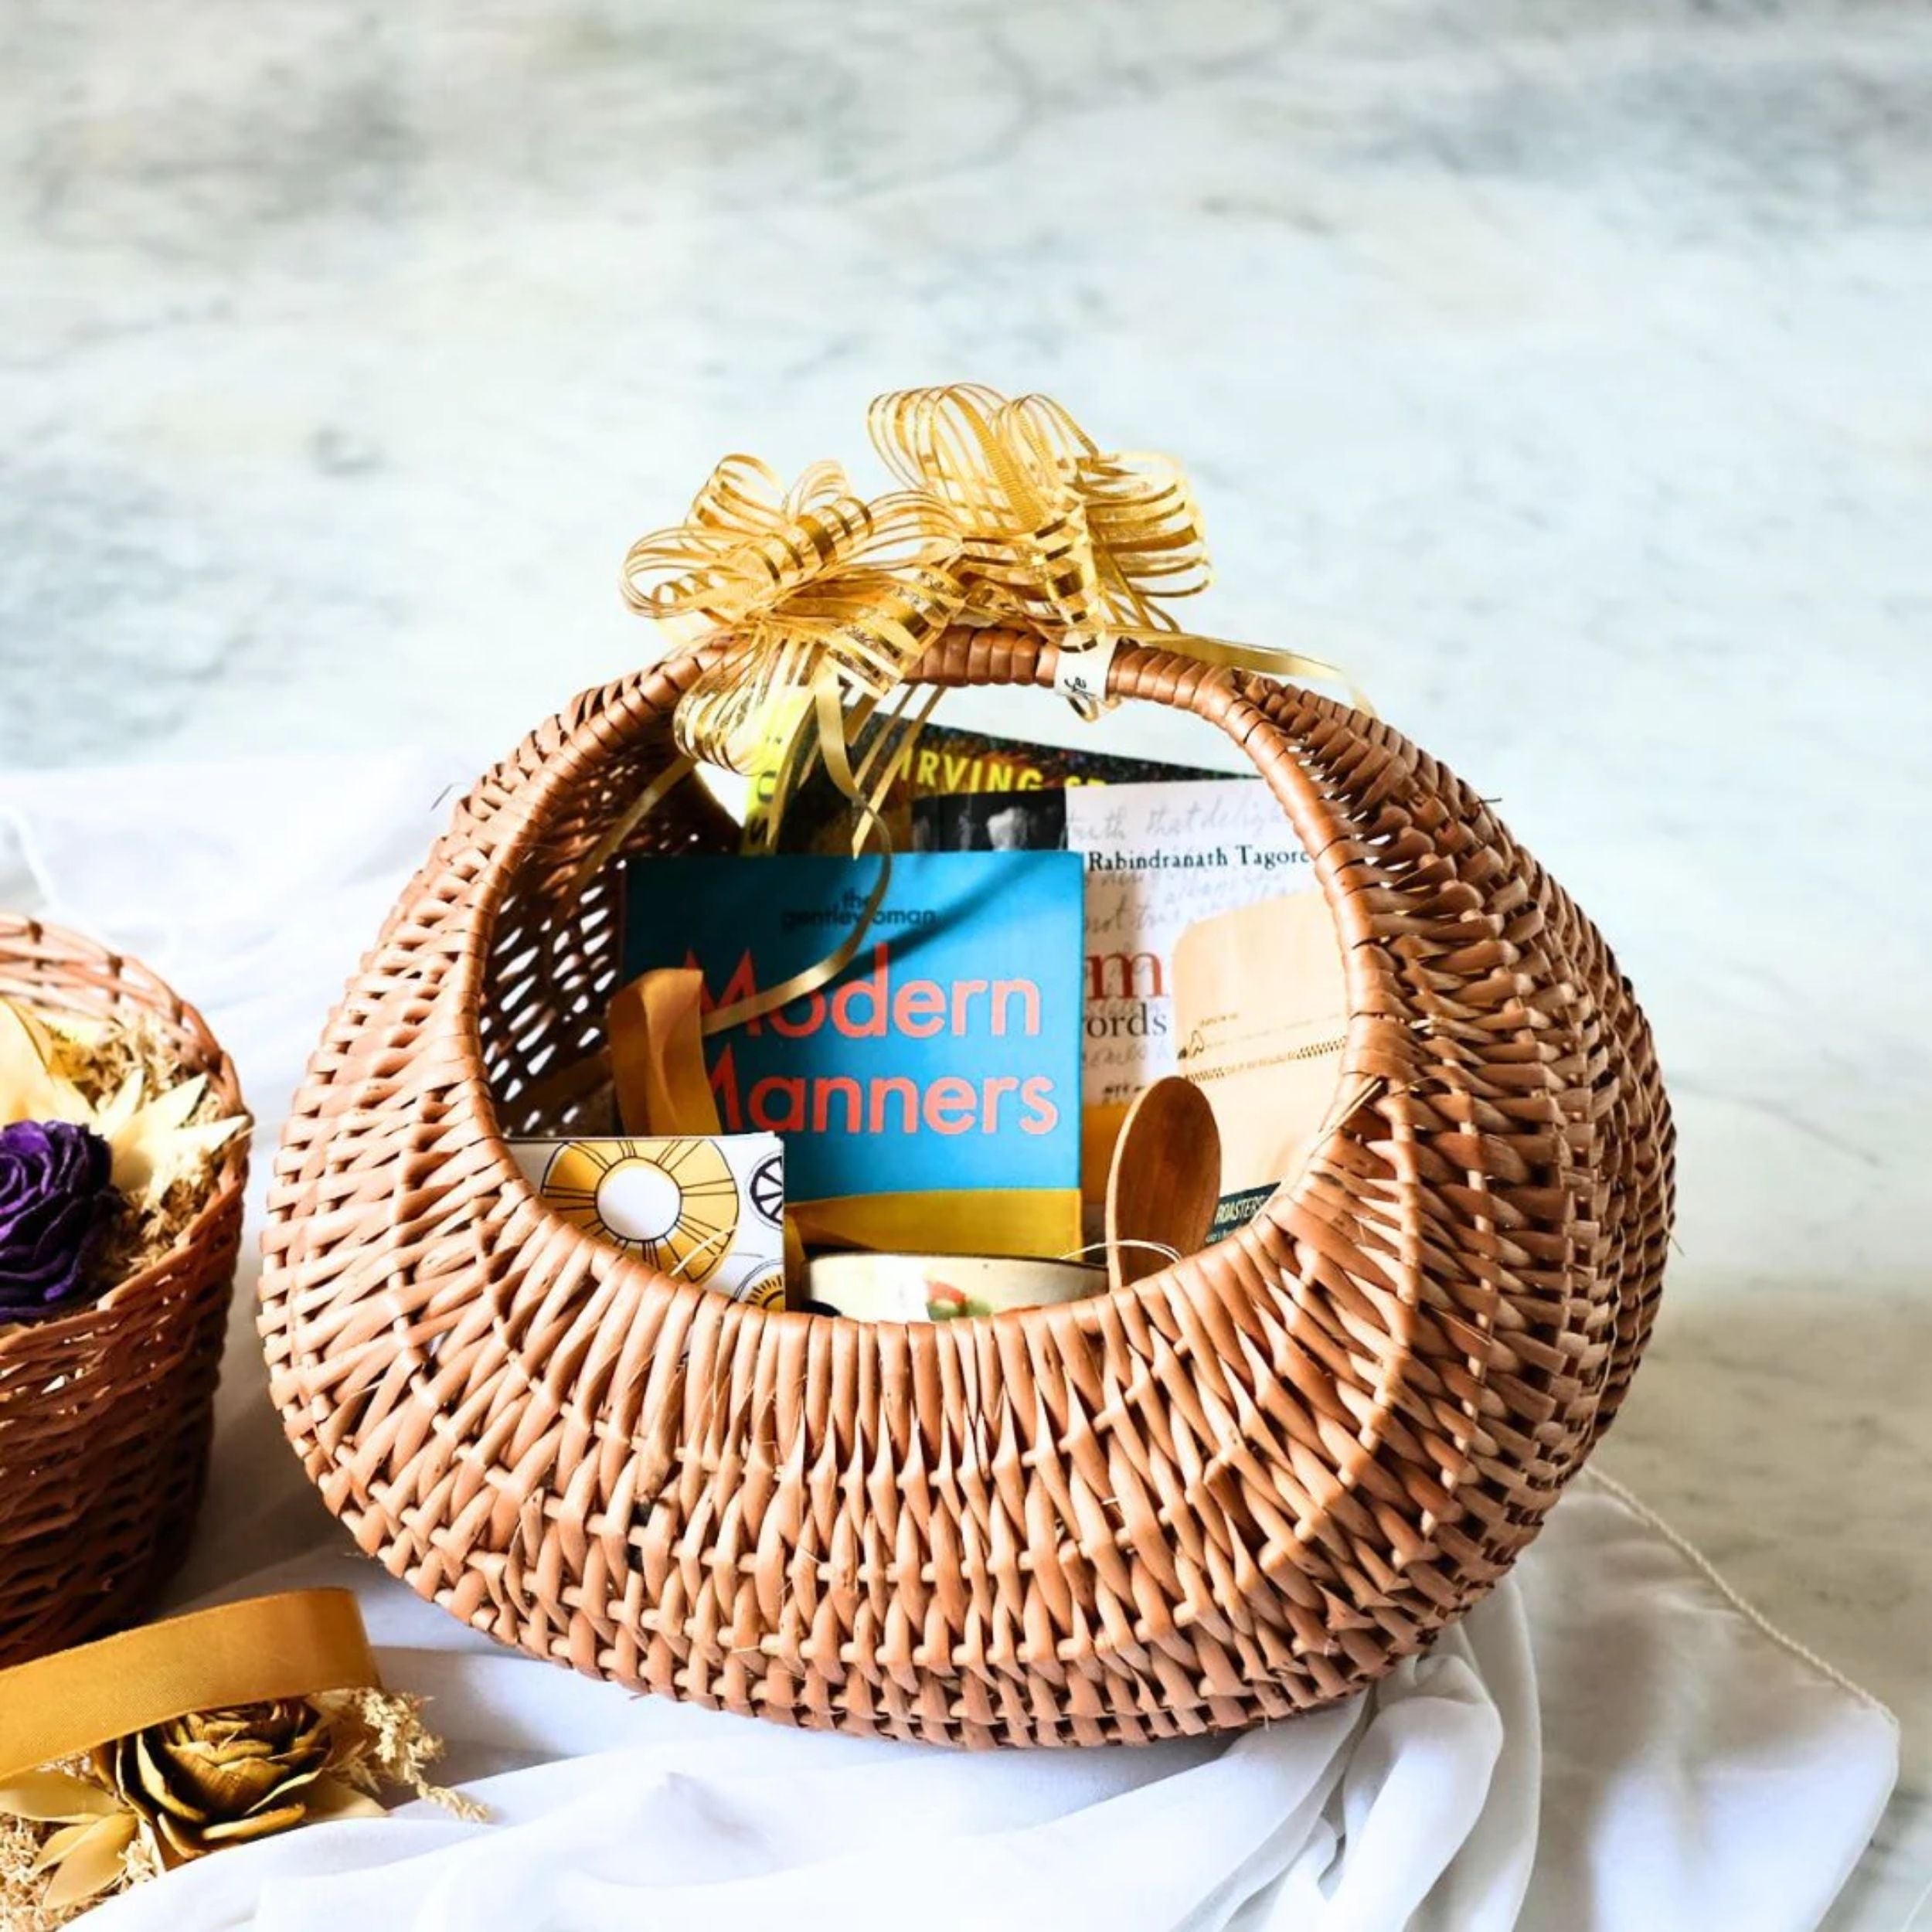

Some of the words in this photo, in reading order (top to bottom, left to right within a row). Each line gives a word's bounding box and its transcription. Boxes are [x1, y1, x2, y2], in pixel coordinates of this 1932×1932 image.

[1088, 847, 1229, 872] Rabindranath
[1235, 843, 1311, 869] Tagore
[684, 943, 1041, 1039] Modern
[1084, 1002, 1168, 1038] ords
